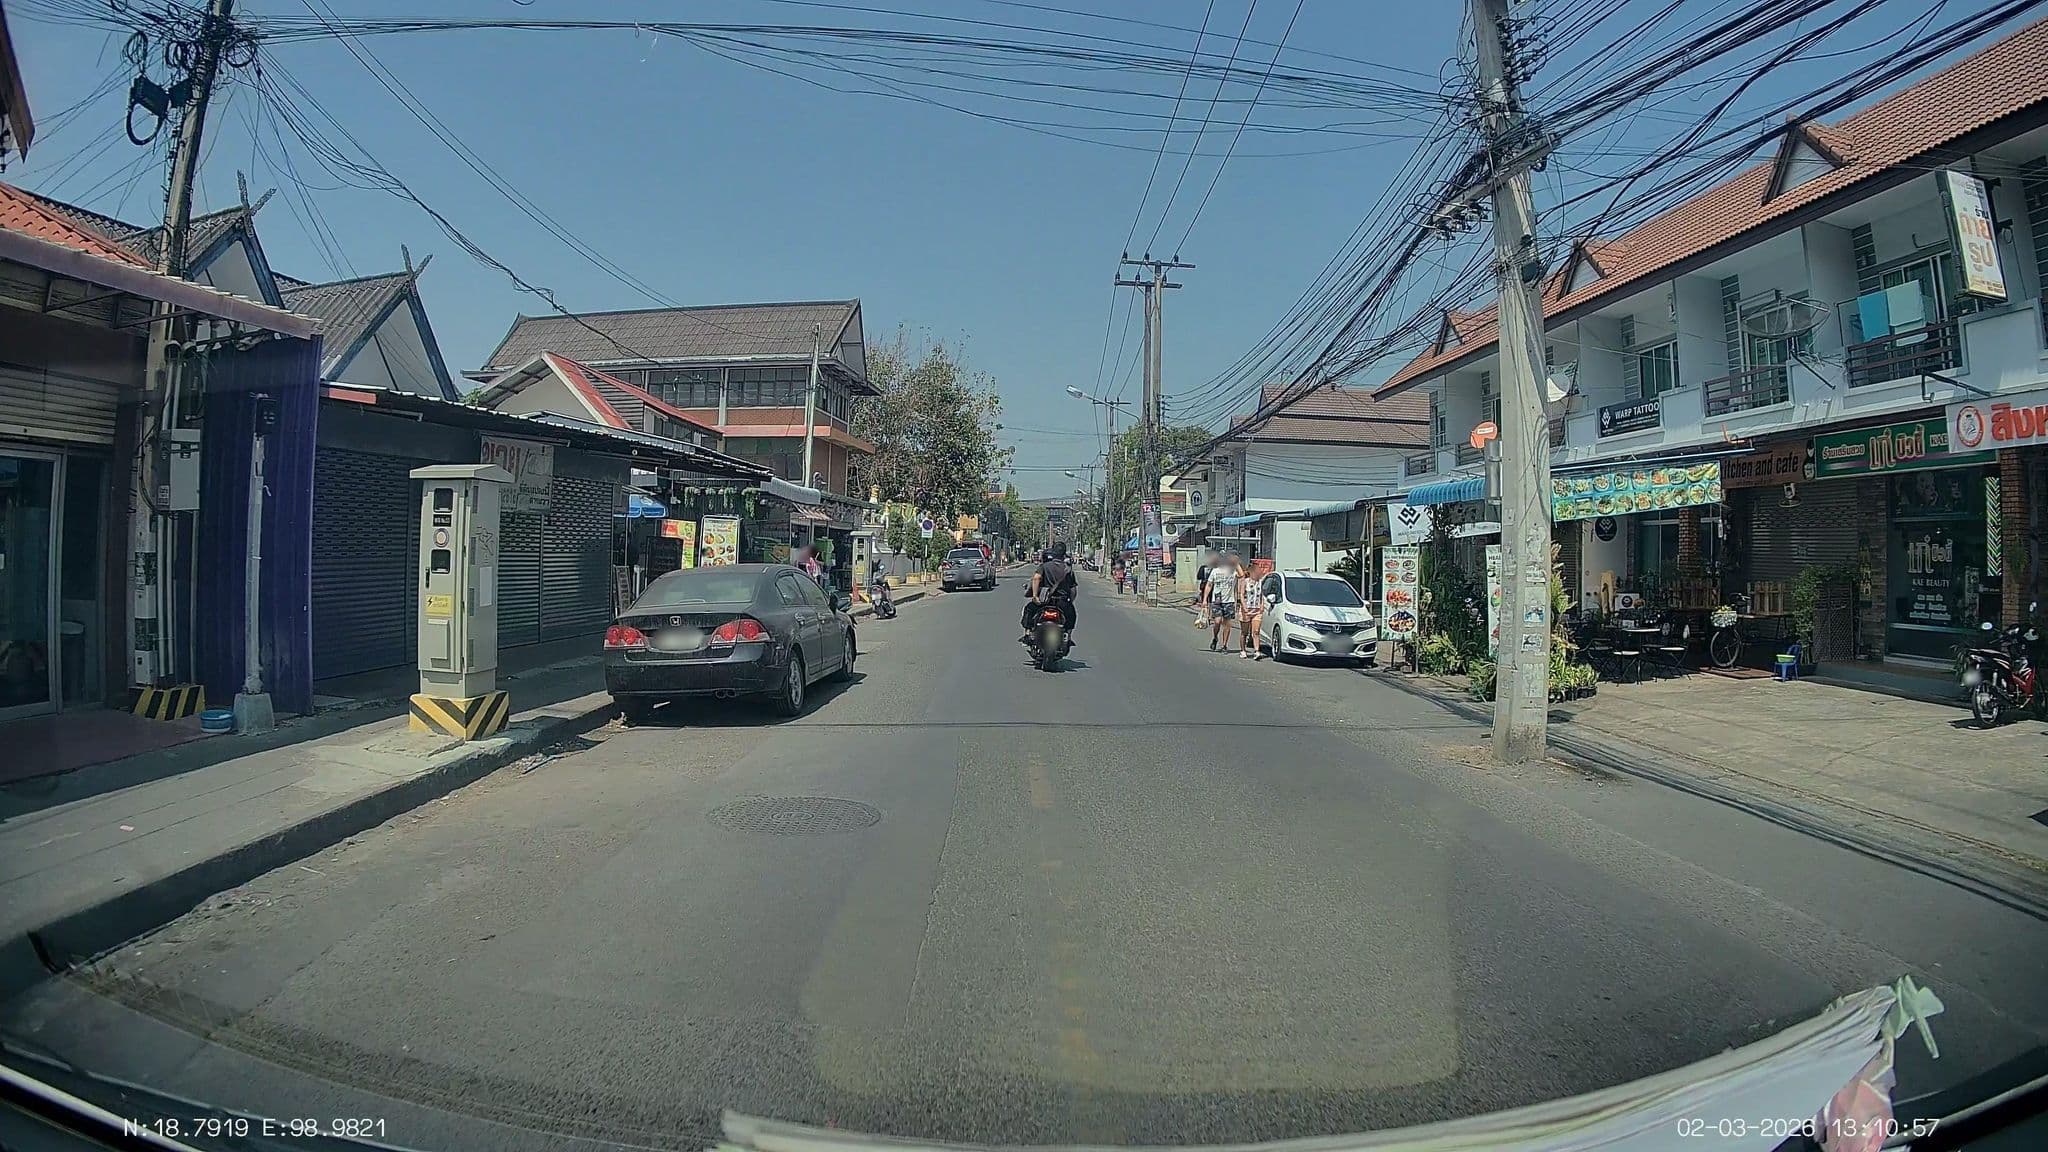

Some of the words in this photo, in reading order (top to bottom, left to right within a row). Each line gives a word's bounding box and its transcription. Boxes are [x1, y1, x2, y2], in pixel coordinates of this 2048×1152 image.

[1615, 408, 1632, 420] WARP
[1633, 402, 1660, 415] TATTOO
[1723, 459, 1753, 479] itchen
[1755, 455, 1774, 476] and
[1776, 452, 1799, 475] cafe
[1912, 579, 1925, 587] KAE
[1926, 579, 1950, 588] BEAUTY
